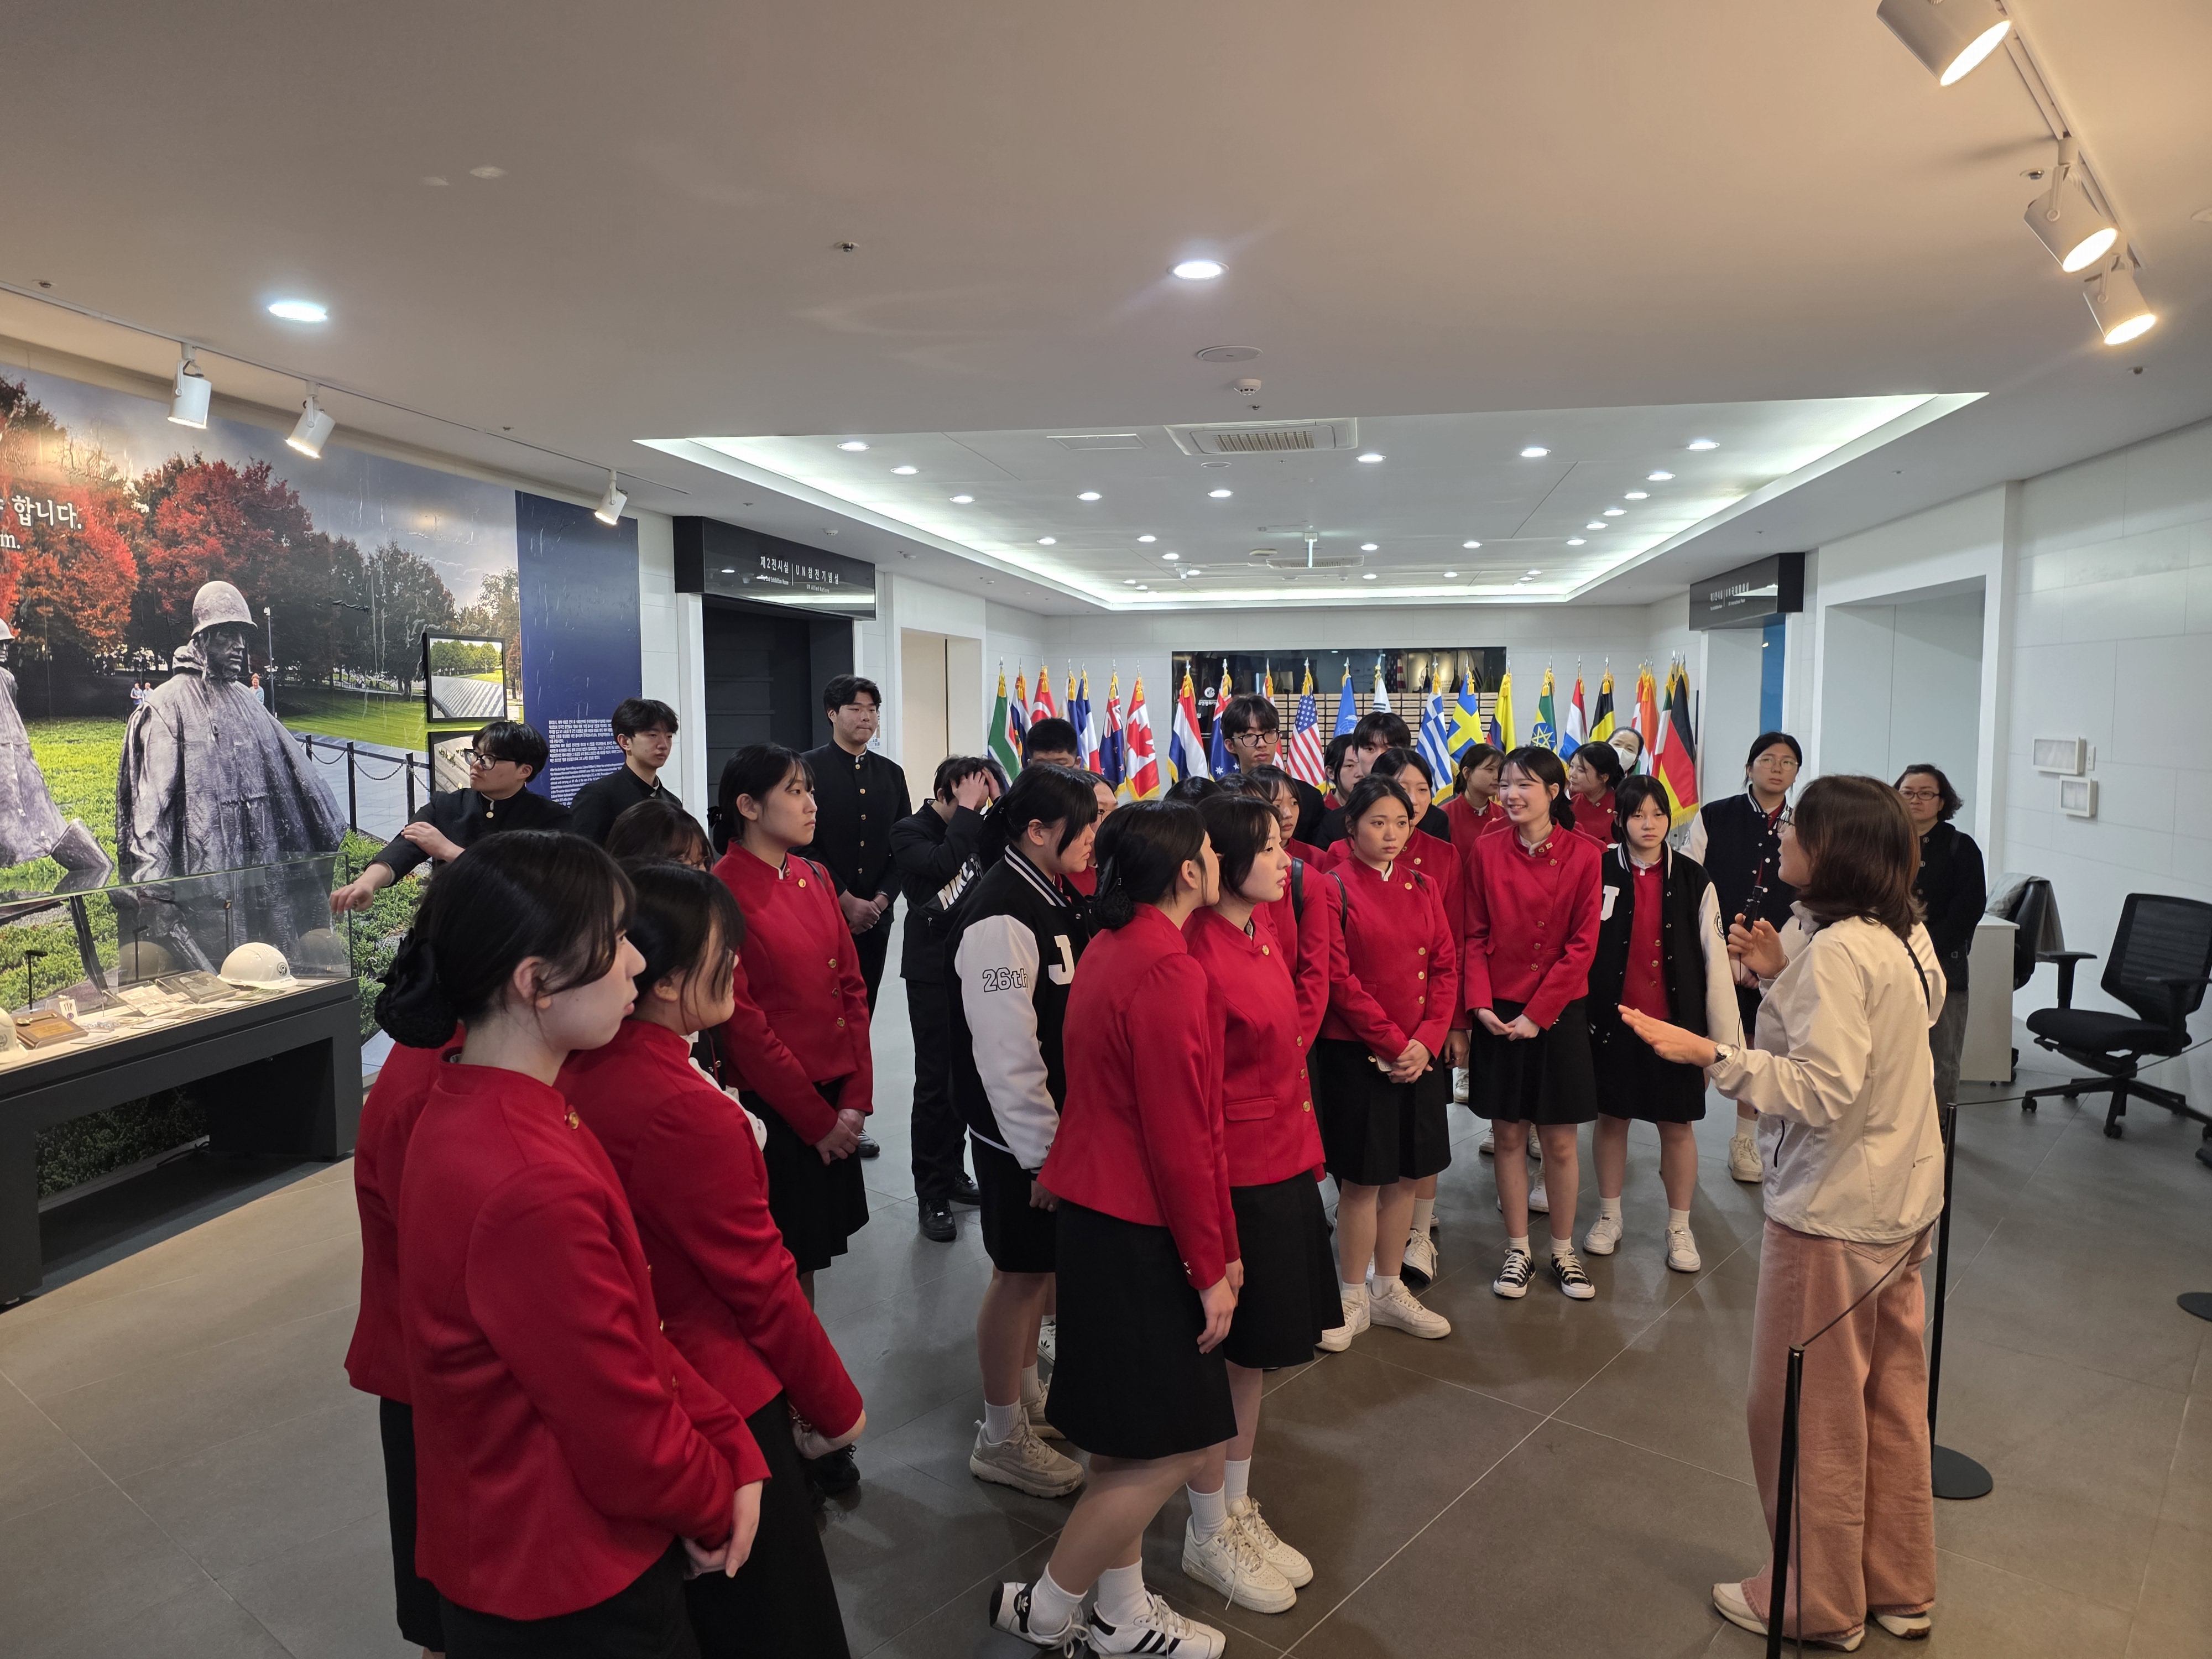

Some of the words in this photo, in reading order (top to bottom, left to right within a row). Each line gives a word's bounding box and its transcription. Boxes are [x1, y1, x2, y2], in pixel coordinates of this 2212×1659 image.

[12, 495, 82, 529] 합니다.
[760, 556, 789, 573] 제2전시실
[937, 862, 974, 911] NIKE
[1048, 935, 1076, 985] J
[983, 968, 1028, 993] 26th
